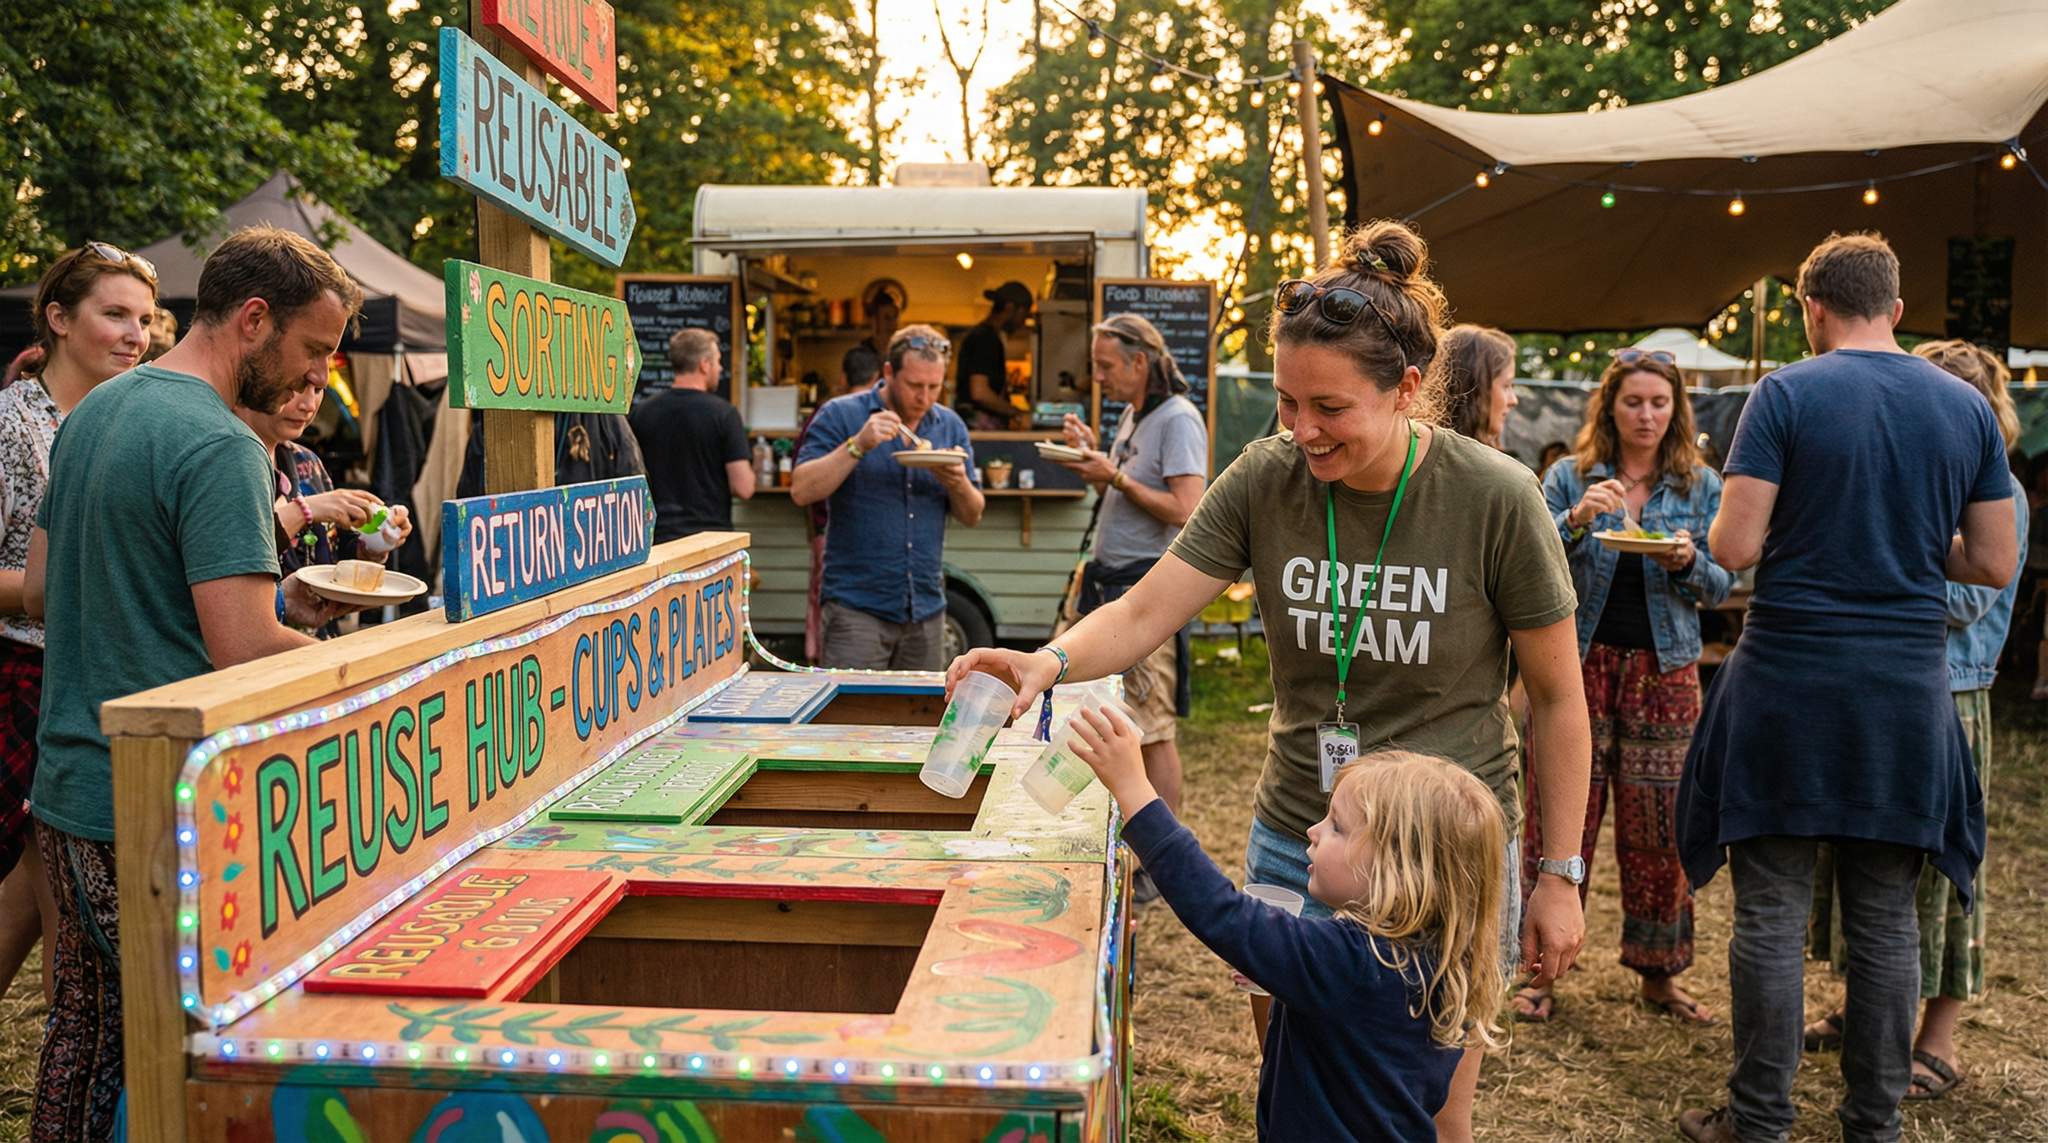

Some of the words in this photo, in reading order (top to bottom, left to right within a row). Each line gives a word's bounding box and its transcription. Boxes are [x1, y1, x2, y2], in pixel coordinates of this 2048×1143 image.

[474, 56, 616, 251] REUSABLE
[486, 280, 617, 403] SORTING
[470, 503, 566, 601] RETURN
[572, 488, 645, 570] STATION
[1281, 556, 1448, 613] GREEN
[1287, 607, 1431, 665] TEAM
[256, 691, 449, 939] REUSE
[572, 613, 642, 741] CUPS
[648, 607, 664, 698] &
[668, 576, 737, 688] PLATES
